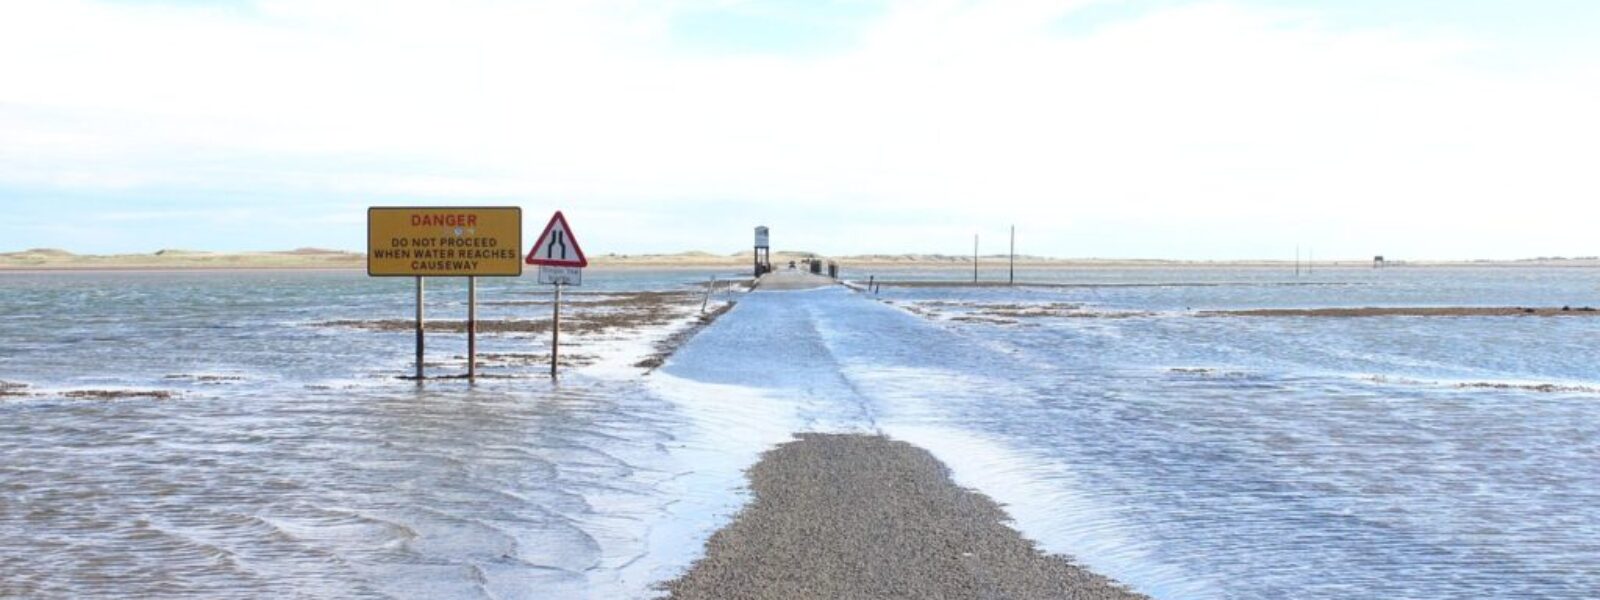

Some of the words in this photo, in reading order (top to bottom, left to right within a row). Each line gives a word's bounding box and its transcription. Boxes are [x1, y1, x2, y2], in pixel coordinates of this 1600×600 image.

[411, 214, 477, 226] DANGER
[392, 238, 408, 247] DO
[412, 238, 436, 247] NOT
[440, 238, 497, 247] PROCEED
[375, 249, 410, 258] WHEN
[414, 249, 454, 258] WATER
[459, 249, 515, 258] REACHES
[411, 261, 478, 270] CAUSEWAY
